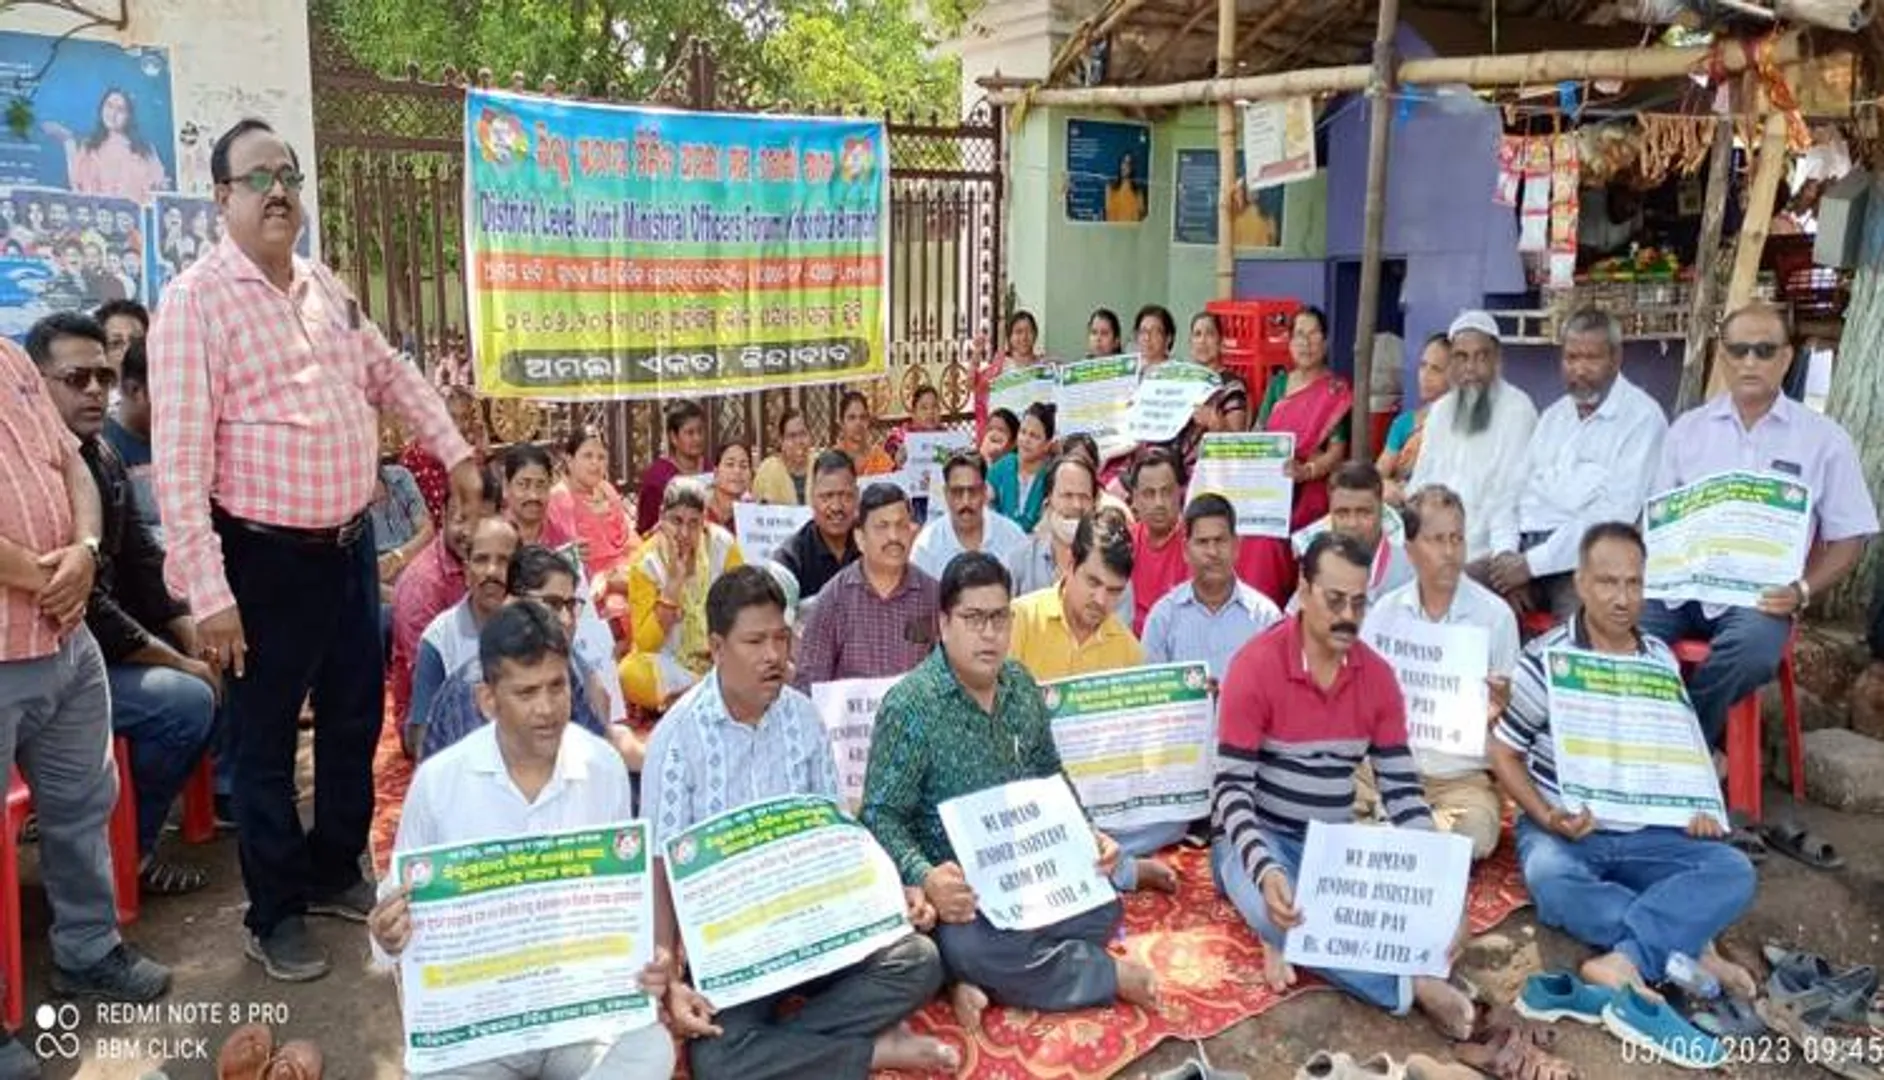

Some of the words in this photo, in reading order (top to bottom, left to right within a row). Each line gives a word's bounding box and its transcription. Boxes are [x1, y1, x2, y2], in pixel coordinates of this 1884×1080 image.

[481, 190, 536, 234] District
[542, 197, 575, 237] Level
[578, 199, 619, 239] Joint
[691, 202, 744, 241] Officers
[1334, 906, 1376, 929] GRADE
[1380, 910, 1407, 933] PAY
[1374, 941, 1411, 963] LEVEL
